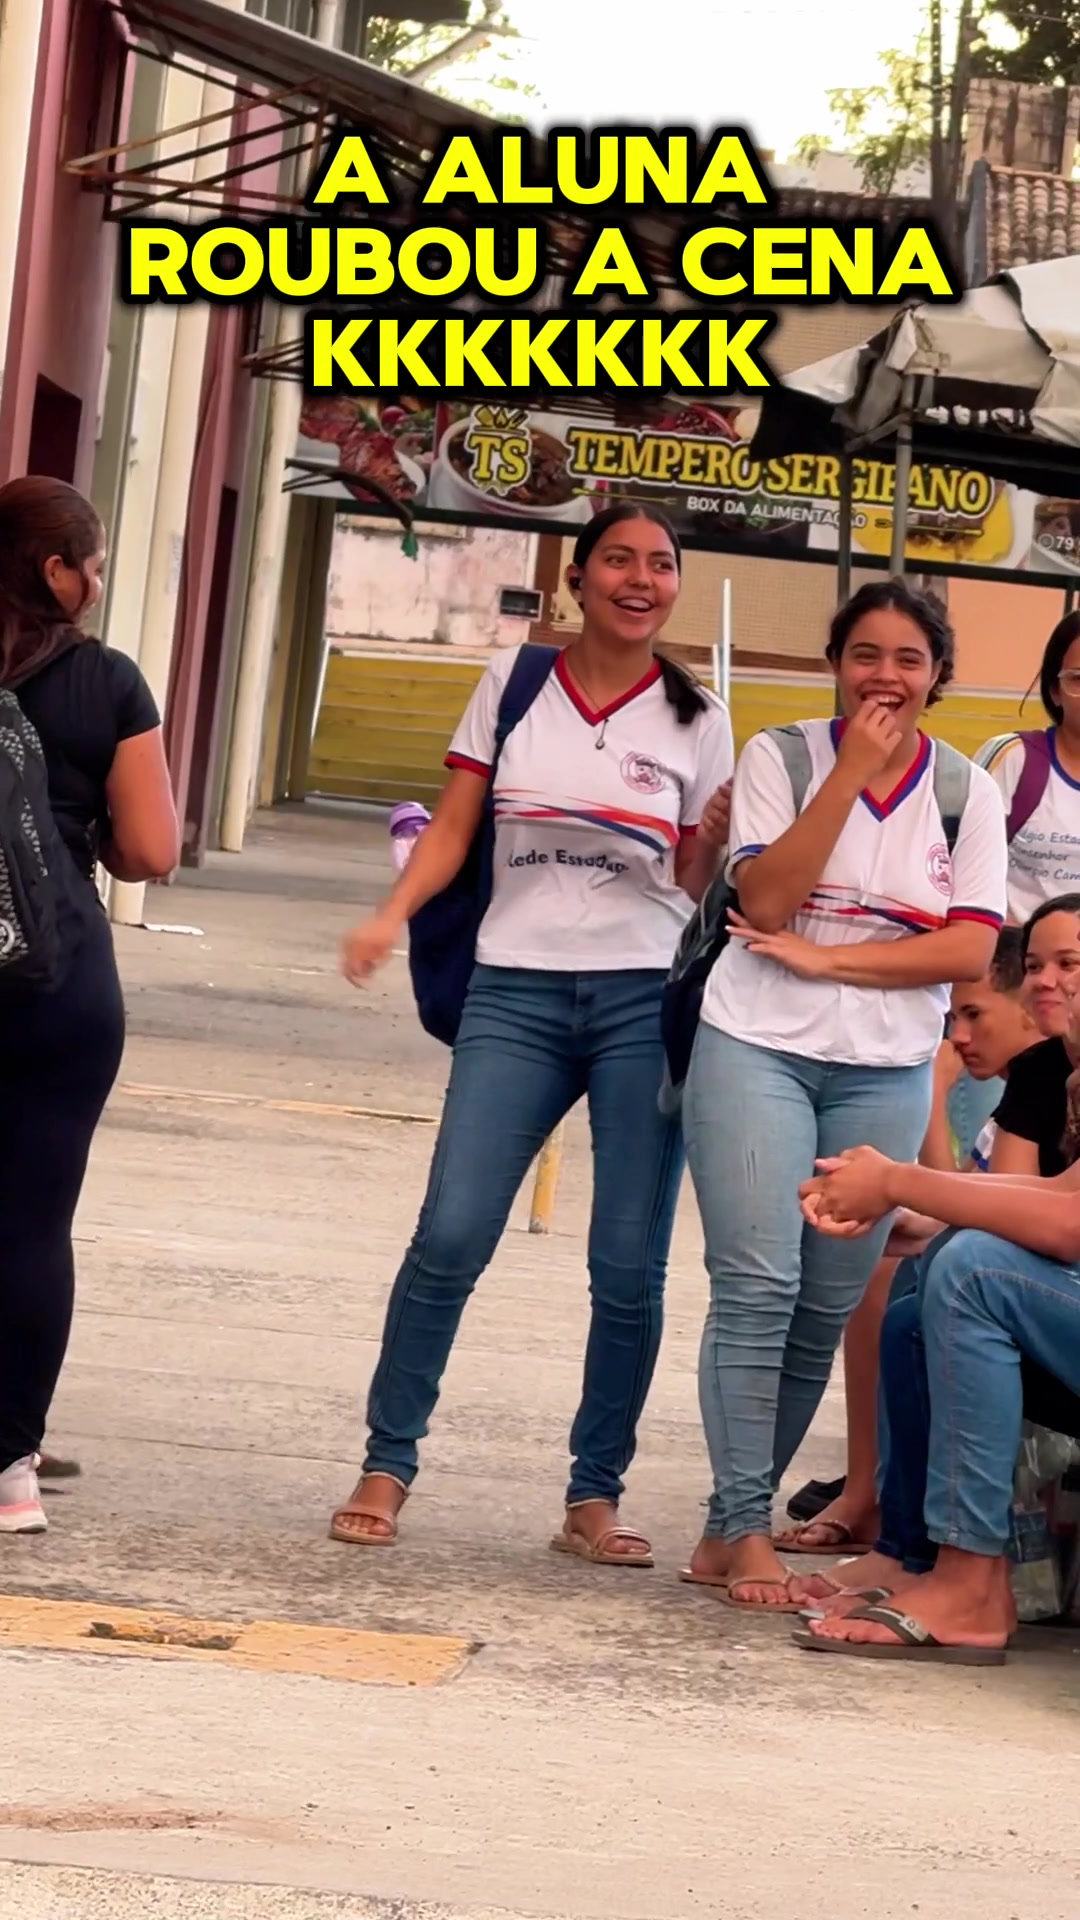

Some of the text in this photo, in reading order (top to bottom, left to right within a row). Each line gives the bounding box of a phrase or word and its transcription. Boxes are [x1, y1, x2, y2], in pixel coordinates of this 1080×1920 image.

[467, 432, 530, 484] TS
[567, 427, 761, 490] TEMPERO
[686, 495, 721, 513] BOX
[724, 499, 747, 516] DA
[1055, 535, 1075, 551] 79
